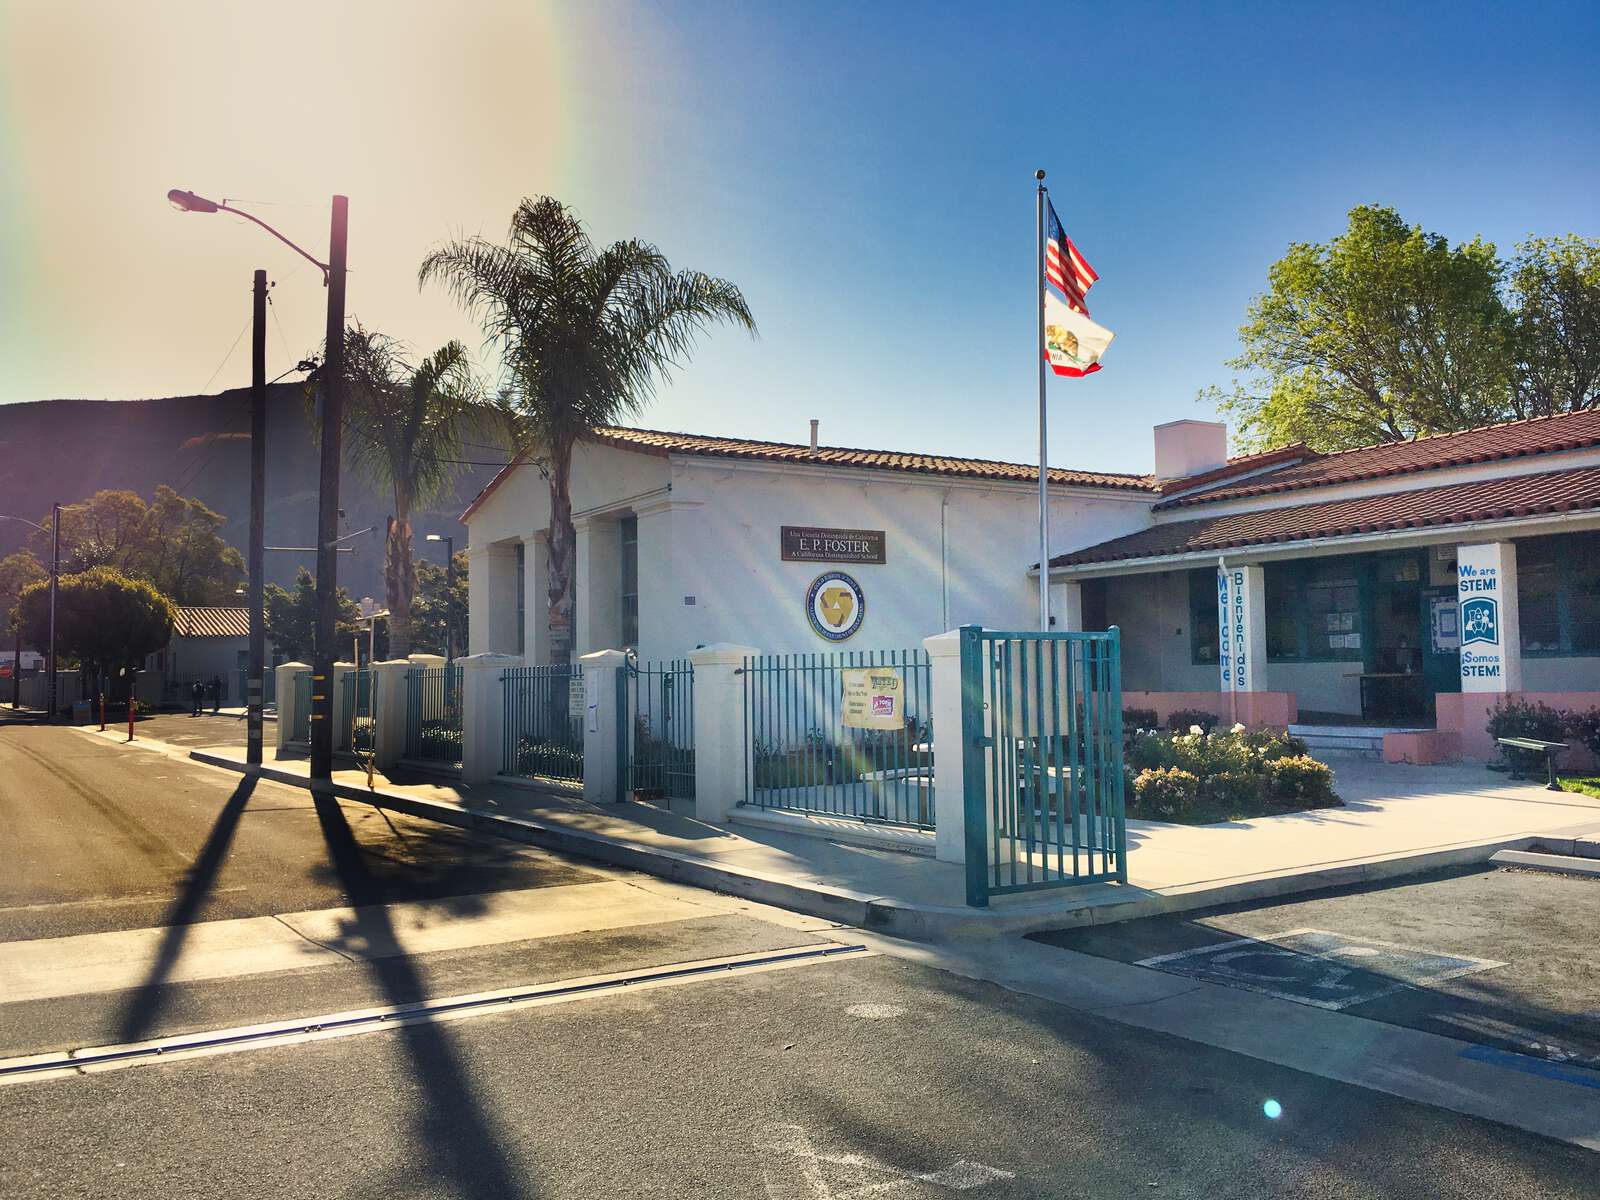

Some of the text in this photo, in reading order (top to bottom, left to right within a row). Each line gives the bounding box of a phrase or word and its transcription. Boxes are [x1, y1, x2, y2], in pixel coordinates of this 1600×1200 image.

[800, 538, 870, 553] E. P. FOSTER
[1458, 565, 1496, 577] We are
[1460, 578, 1497, 592] STEM!
[1218, 575, 1231, 681] Welcome
[1234, 572, 1246, 686] Bienvenidos
[1462, 665, 1500, 677] STEM!
